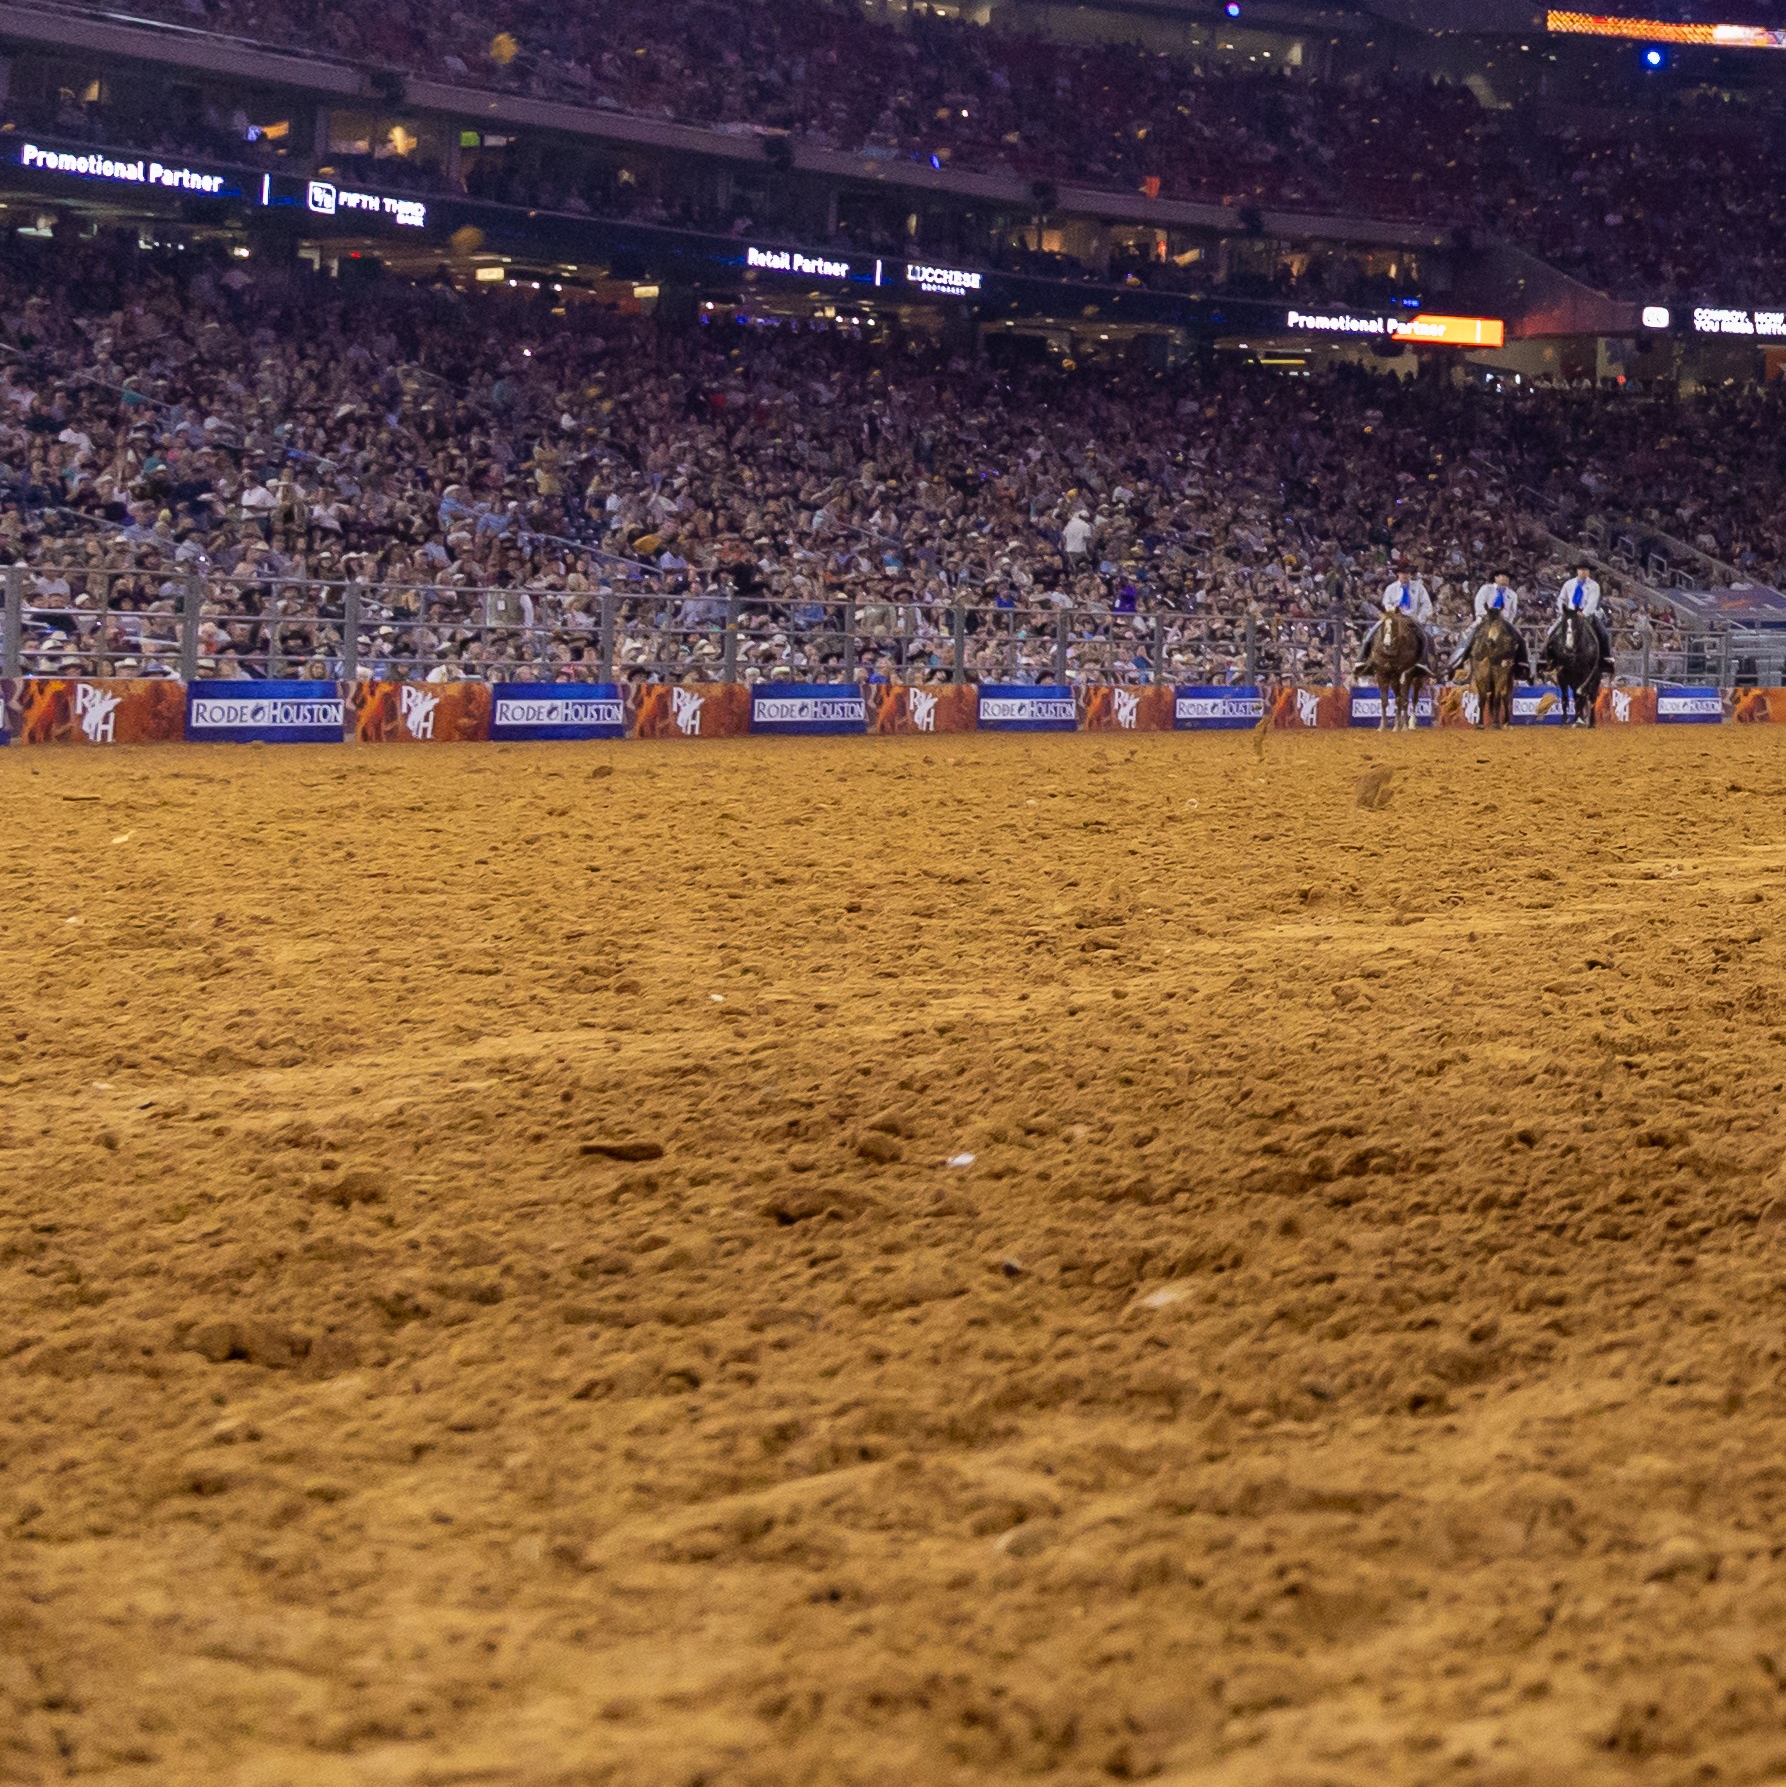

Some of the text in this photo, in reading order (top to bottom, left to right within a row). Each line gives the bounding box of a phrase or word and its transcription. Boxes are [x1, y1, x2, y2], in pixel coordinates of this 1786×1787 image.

[23, 143, 224, 192] Promotional Partner
[338, 190, 426, 218] FIFTH THIRD
[747, 246, 849, 278] Retail Partner
[906, 264, 982, 289] LUCCHESE
[1287, 310, 1447, 338] Promotional Partner
[196, 702, 342, 724] RODEO HOUSTON
[500, 702, 622, 722] RODEO HOUSTON
[757, 700, 865, 719] RODEO HOUSTON
[983, 699, 1075, 718] RODEO HOUSTON
[1178, 700, 1262, 716] RODEO HOUST
[1354, 700, 1382, 715] RODE
